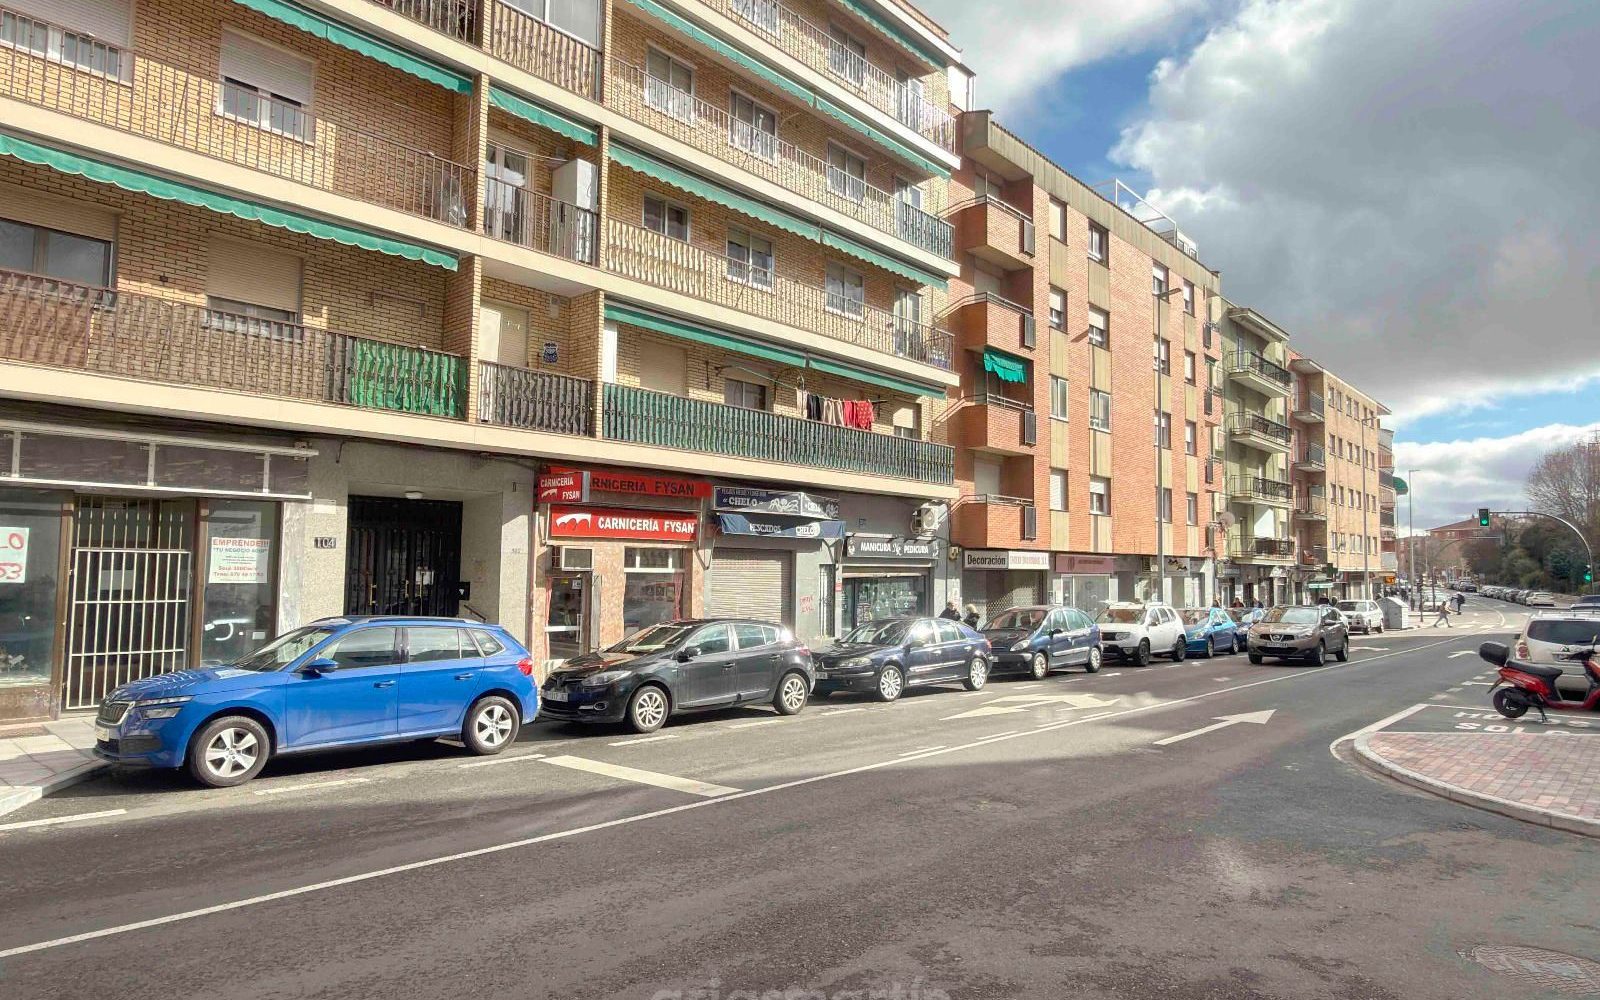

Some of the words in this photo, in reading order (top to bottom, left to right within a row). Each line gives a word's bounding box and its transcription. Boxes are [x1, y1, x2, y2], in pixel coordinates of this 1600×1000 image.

[590, 477, 646, 492] RNICERIA
[655, 481, 695, 496] FYSAN
[562, 490, 580, 500] FYSAN
[728, 497, 758, 507] CHELO
[664, 521, 695, 534] FYSAN
[317, 537, 335, 548] 104
[860, 542, 892, 552] MANICURA
[903, 545, 929, 554] PEDICURA
[967, 554, 1006, 566] Decoración
